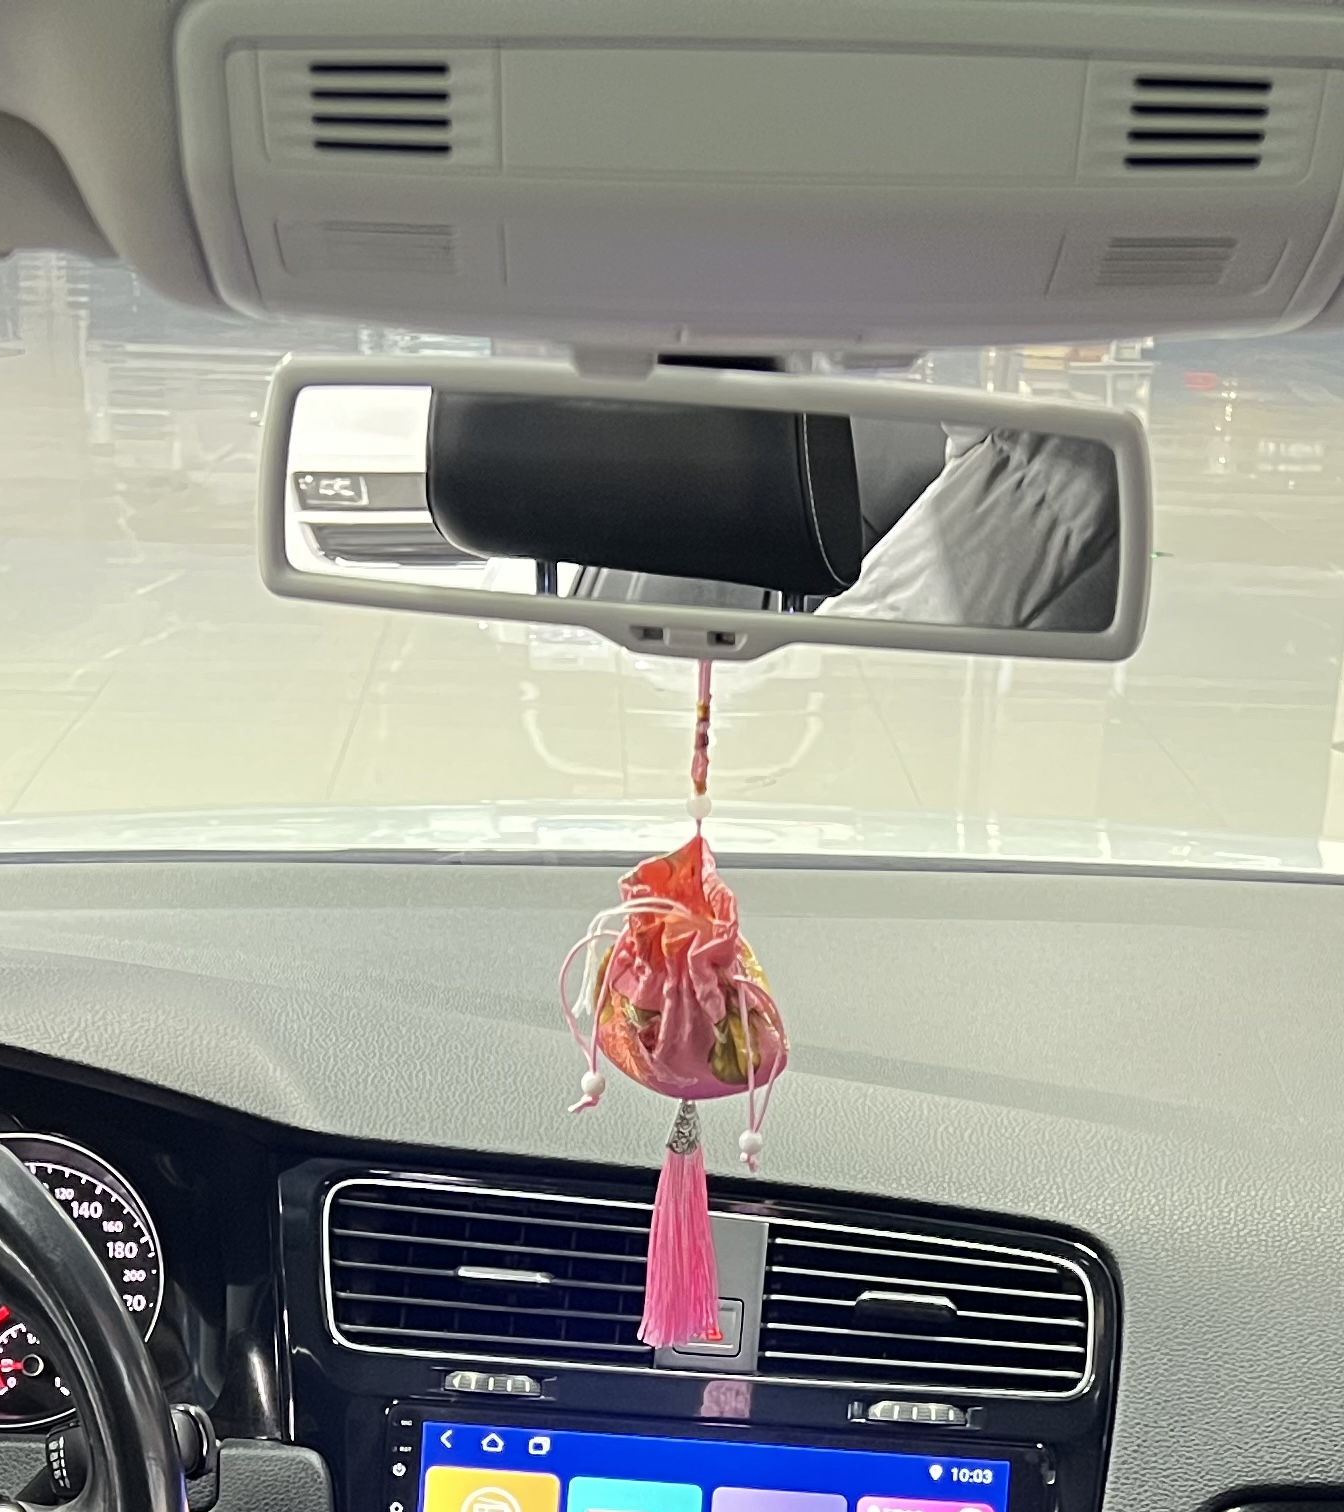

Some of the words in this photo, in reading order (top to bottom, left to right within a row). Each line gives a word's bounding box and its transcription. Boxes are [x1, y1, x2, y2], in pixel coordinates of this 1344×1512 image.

[55, 1188, 76, 1200] 120
[71, 1201, 103, 1219] 140
[106, 1242, 138, 1258] 180
[951, 1467, 993, 1485] 10:03
